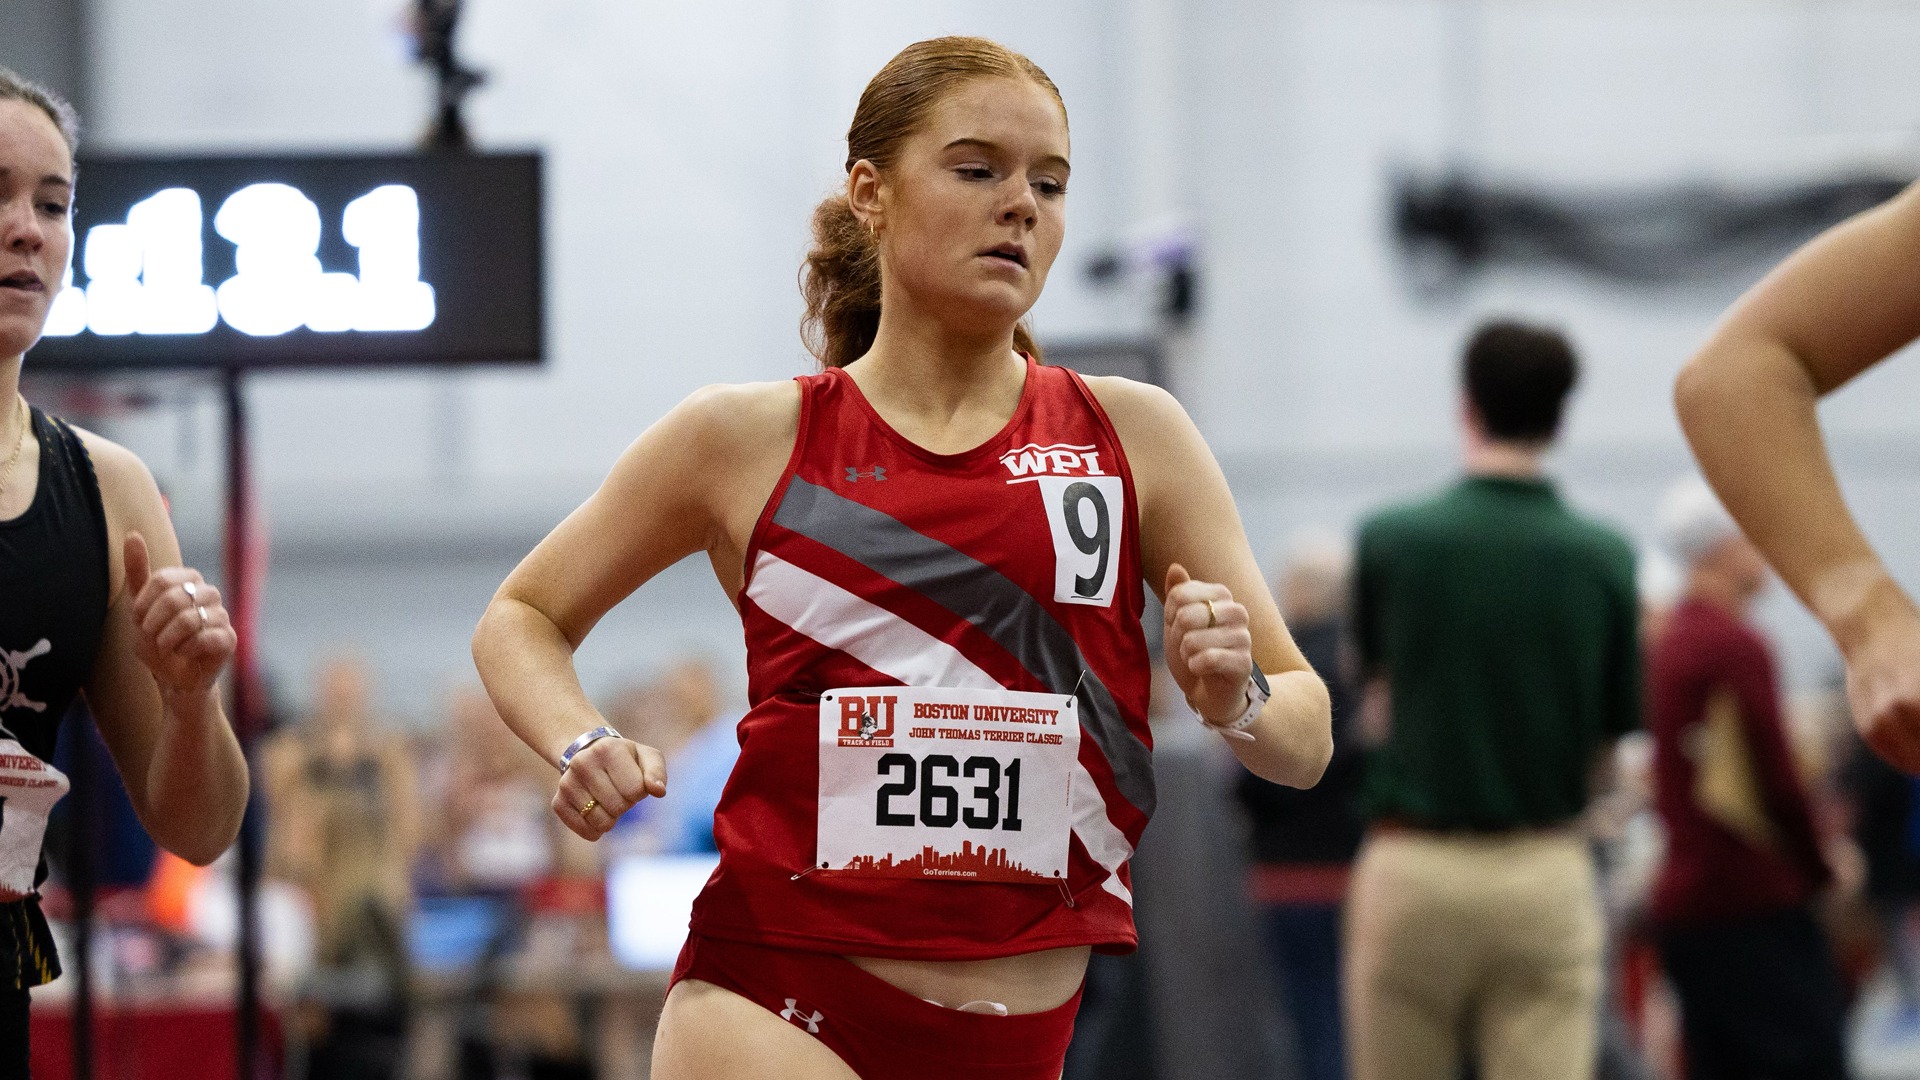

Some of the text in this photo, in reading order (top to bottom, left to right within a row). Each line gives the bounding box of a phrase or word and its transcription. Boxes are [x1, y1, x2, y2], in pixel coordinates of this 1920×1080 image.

[1000, 450, 1105, 476] WPI
[1062, 481, 1110, 597] 9
[838, 696, 898, 738] BU
[913, 703, 1059, 725] BOSTON UNIVERSITY
[909, 728, 1063, 745] JOHN THOMAS TERRIER CLASSIC
[876, 753, 1022, 831] 2631
[923, 868, 977, 877] GoTerriers.com
